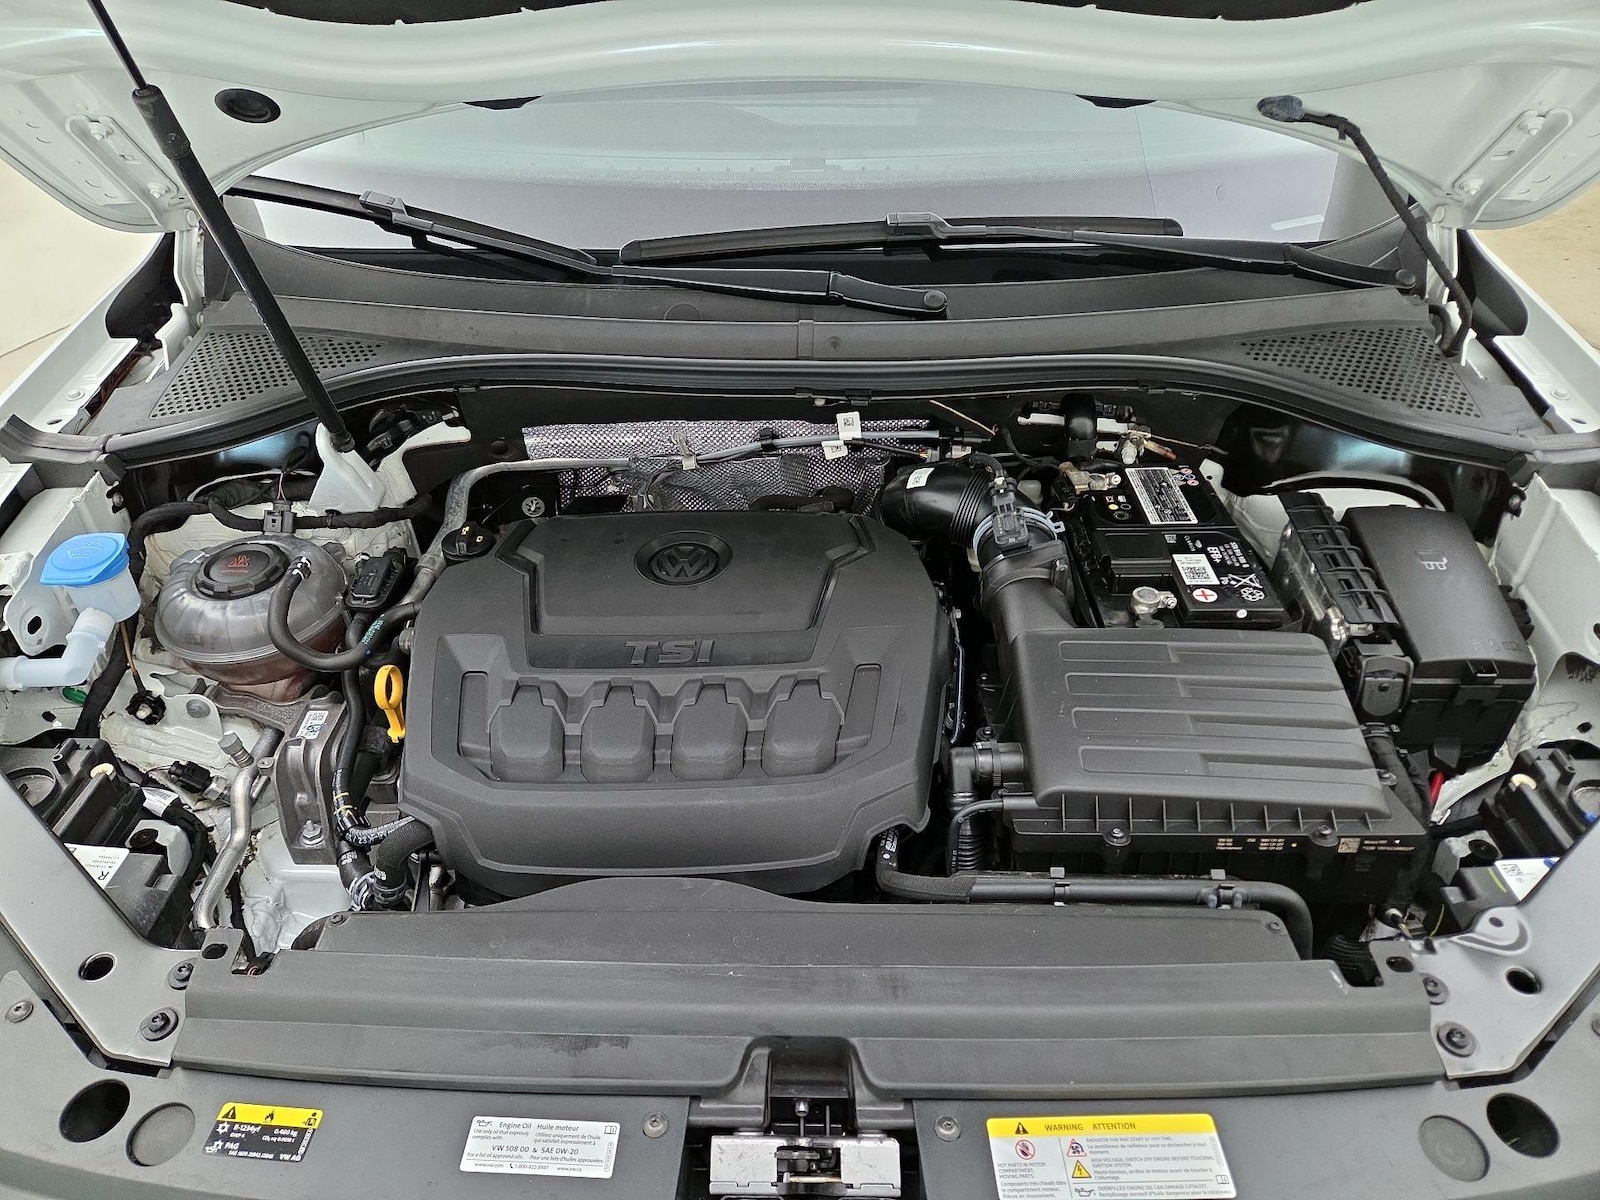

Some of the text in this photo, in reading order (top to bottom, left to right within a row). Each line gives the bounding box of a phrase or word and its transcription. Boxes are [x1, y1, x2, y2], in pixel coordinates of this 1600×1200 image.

[1207, 546, 1222, 563] EFB+
[625, 640, 714, 664] TSI
[98, 871, 110, 880] R
[233, 1124, 261, 1134] R-1234yf
